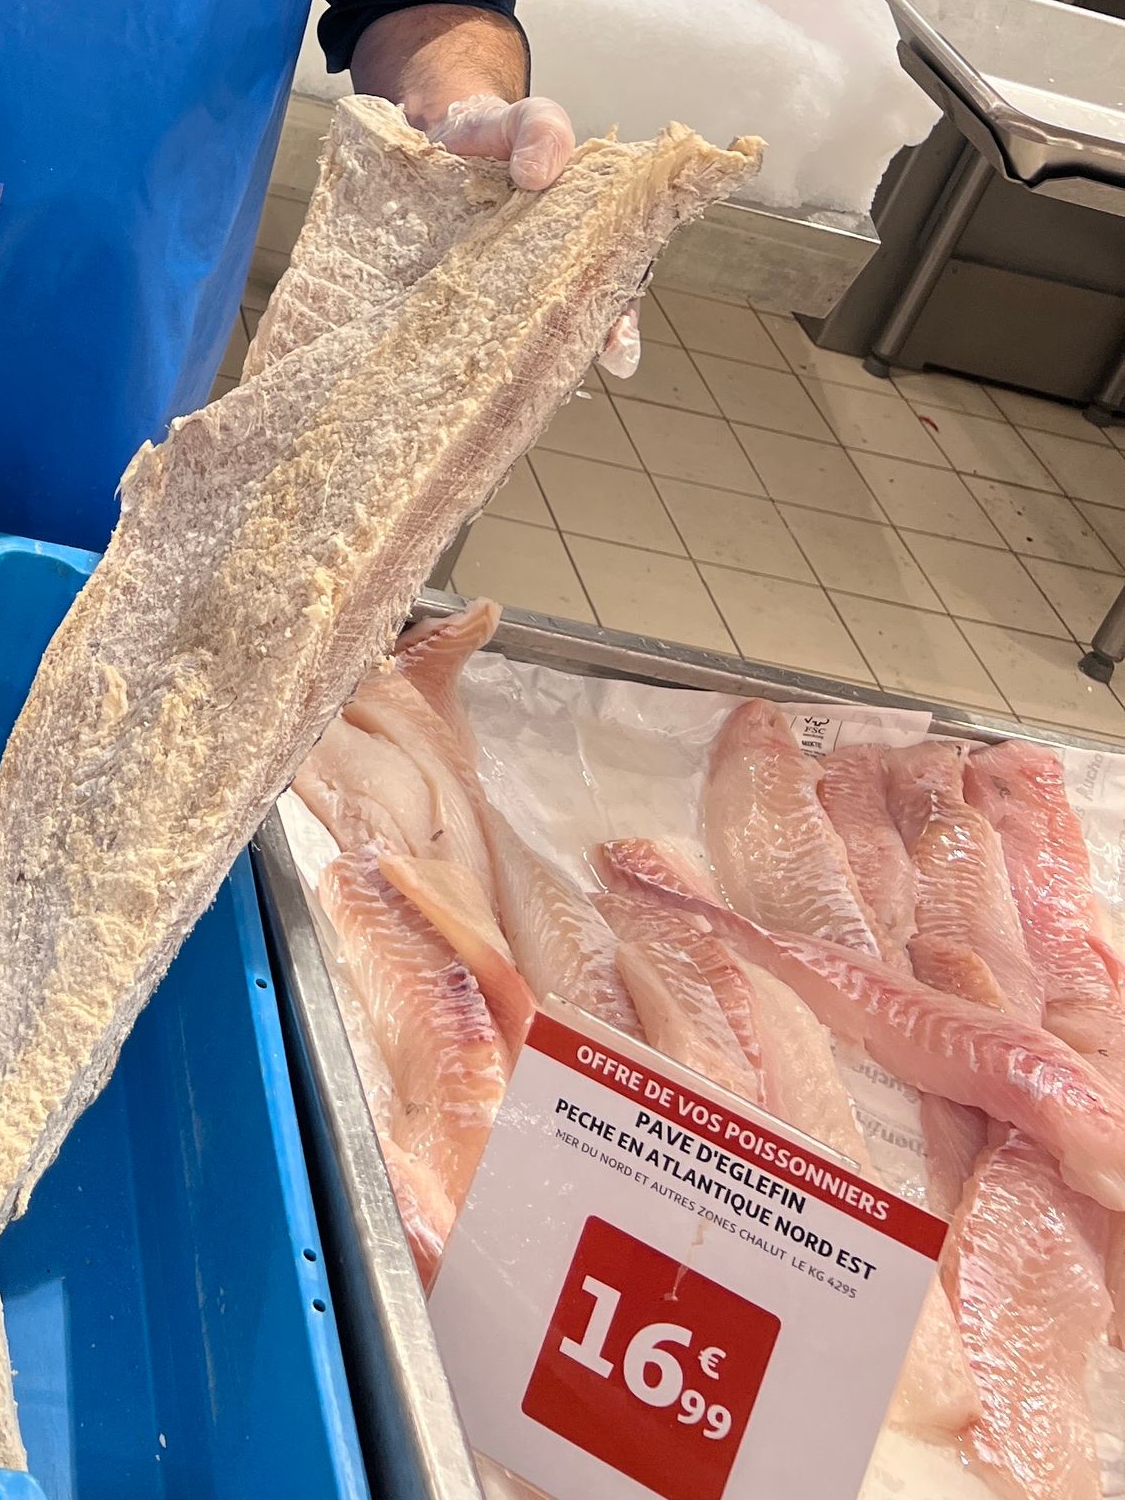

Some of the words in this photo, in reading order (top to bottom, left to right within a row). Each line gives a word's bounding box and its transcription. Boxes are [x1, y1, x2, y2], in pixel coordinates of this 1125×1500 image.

[804, 726, 826, 734] FSC
[555, 1098, 616, 1142] PECHE
[617, 1131, 644, 1157] EN
[645, 1148, 773, 1227] ATLANTIQUE
[774, 1216, 833, 1258] NORD
[836, 1249, 877, 1281] EST
[555, 1128, 580, 1149] MER
[581, 1143, 598, 1158] DU
[600, 1153, 633, 1177] NORD
[635, 1171, 650, 1185] ET
[650, 1180, 696, 1213] AUTRES
[696, 1204, 737, 1235] ZONES
[739, 1229, 788, 1260] CHALUT
[791, 1256, 806, 1272] LE
[808, 1266, 825, 1283] KG
[827, 1277, 857, 1299] 4295
[577, 1045, 643, 1092] OFFRE
[644, 1079, 675, 1108] DE
[678, 1095, 724, 1133] VOS
[725, 1120, 890, 1221] POISSONNIERS
[635, 1111, 695, 1154] PAVE
[696, 1142, 807, 1215] D'EGLEFIN
